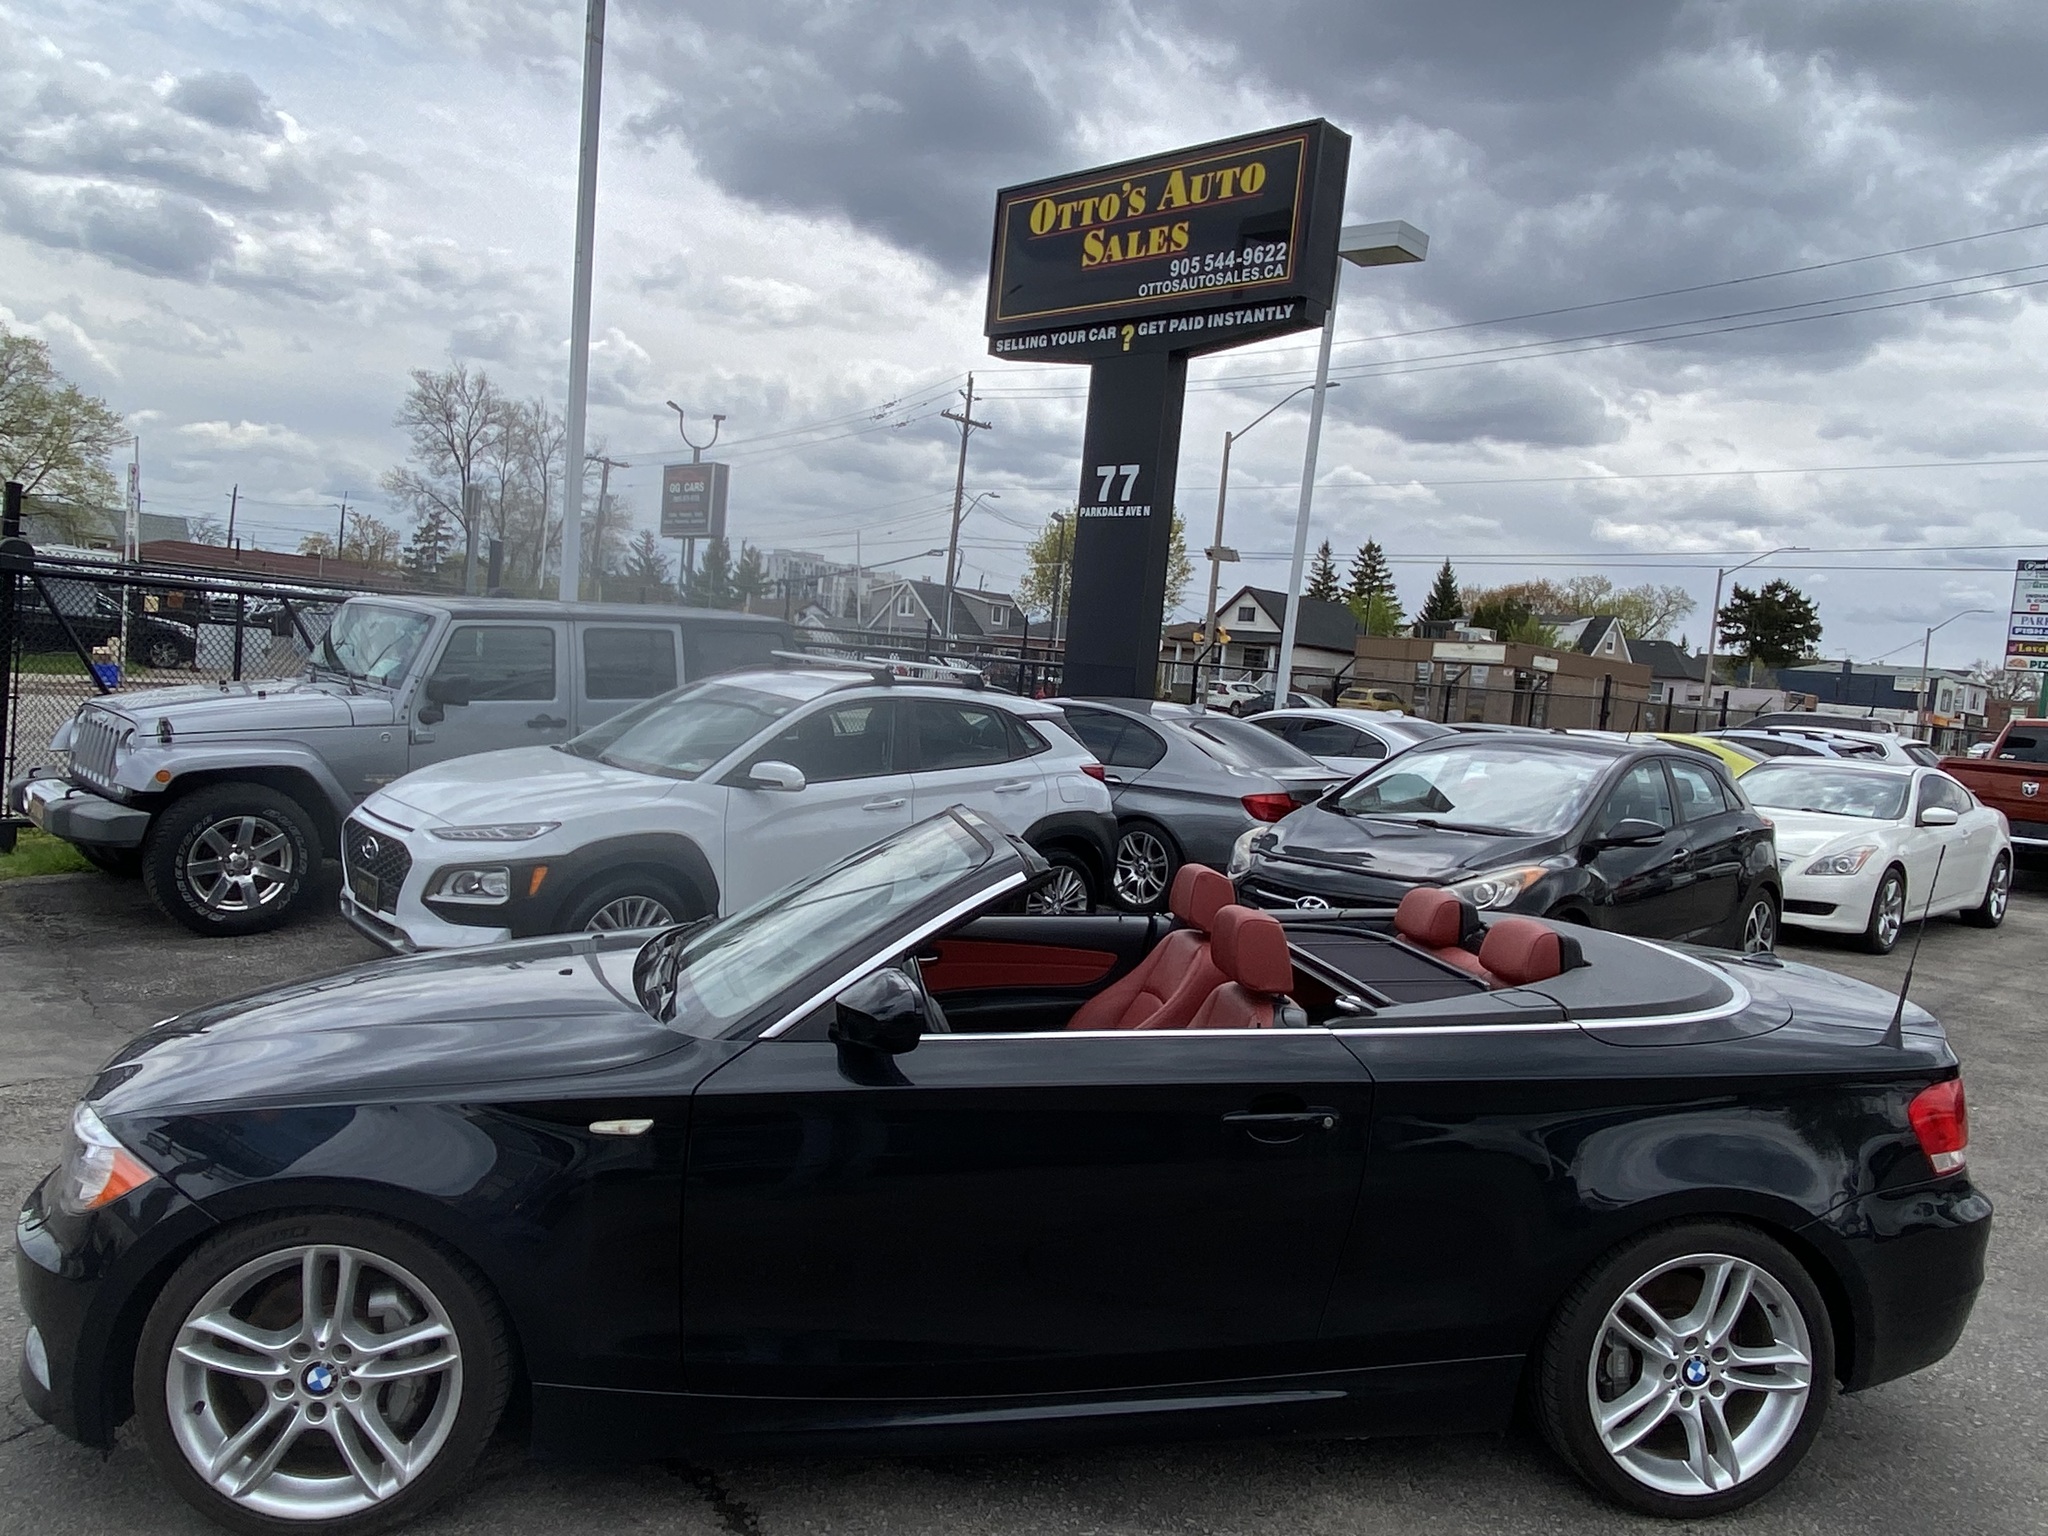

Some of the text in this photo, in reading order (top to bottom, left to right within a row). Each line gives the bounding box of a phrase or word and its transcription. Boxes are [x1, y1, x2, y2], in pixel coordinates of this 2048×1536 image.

[1029, 162, 1266, 236] OTTO'S AUTO
[1081, 220, 1190, 268] SALES
[1170, 242, 1287, 277] 905 544-9622
[1138, 263, 1284, 297] OTTOSAUTOSALES.CA
[996, 335, 1047, 352] SELLING
[1050, 329, 1086, 346] YOUR
[1088, 326, 1117, 341] CAR
[1137, 320, 1166, 336] GET
[1168, 316, 1204, 333] PAID
[1207, 303, 1295, 328] INSTANTLY
[684, 481, 705, 492] CARS
[1096, 464, 1140, 502] 77
[1080, 505, 1151, 517] PARKDALE AVE N
